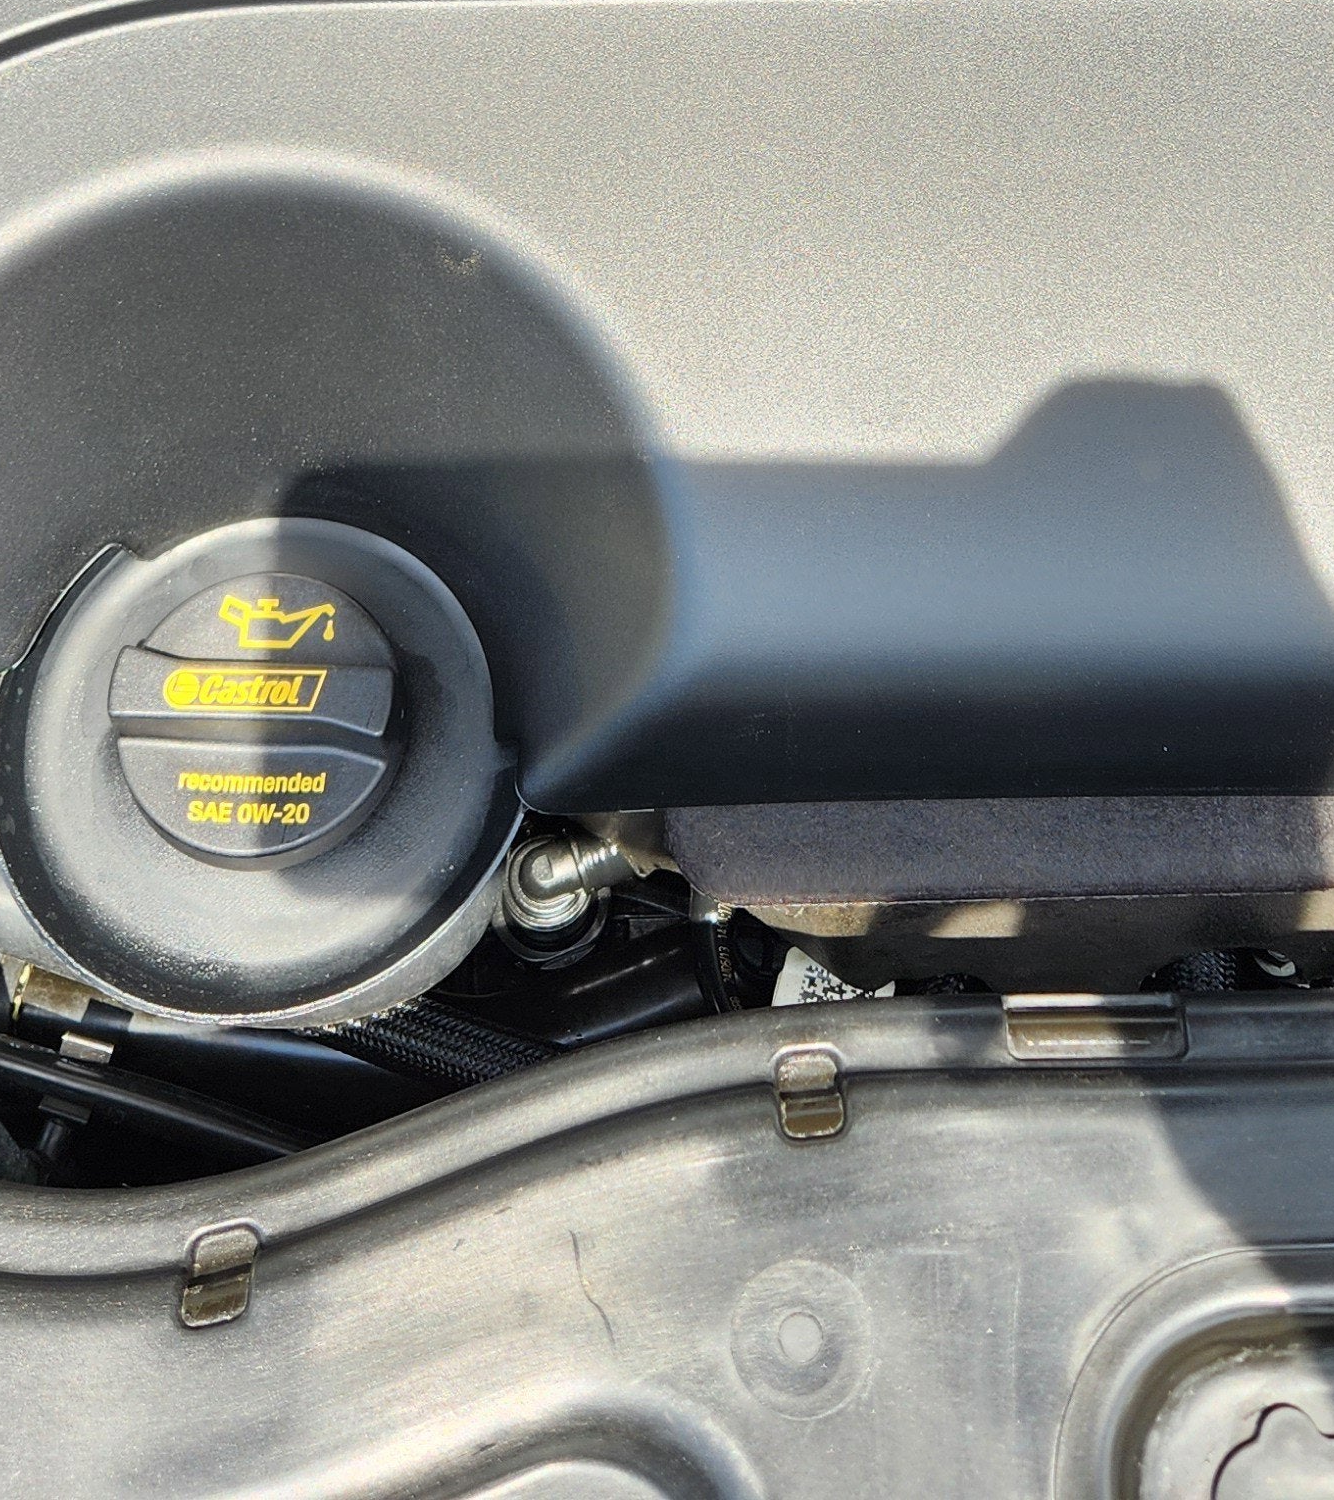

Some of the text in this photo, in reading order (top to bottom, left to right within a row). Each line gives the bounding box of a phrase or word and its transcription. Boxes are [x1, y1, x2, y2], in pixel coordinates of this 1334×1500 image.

[199, 674, 301, 707] Castrol
[178, 771, 326, 795] recommended
[187, 801, 310, 825] SAE 0W-20
